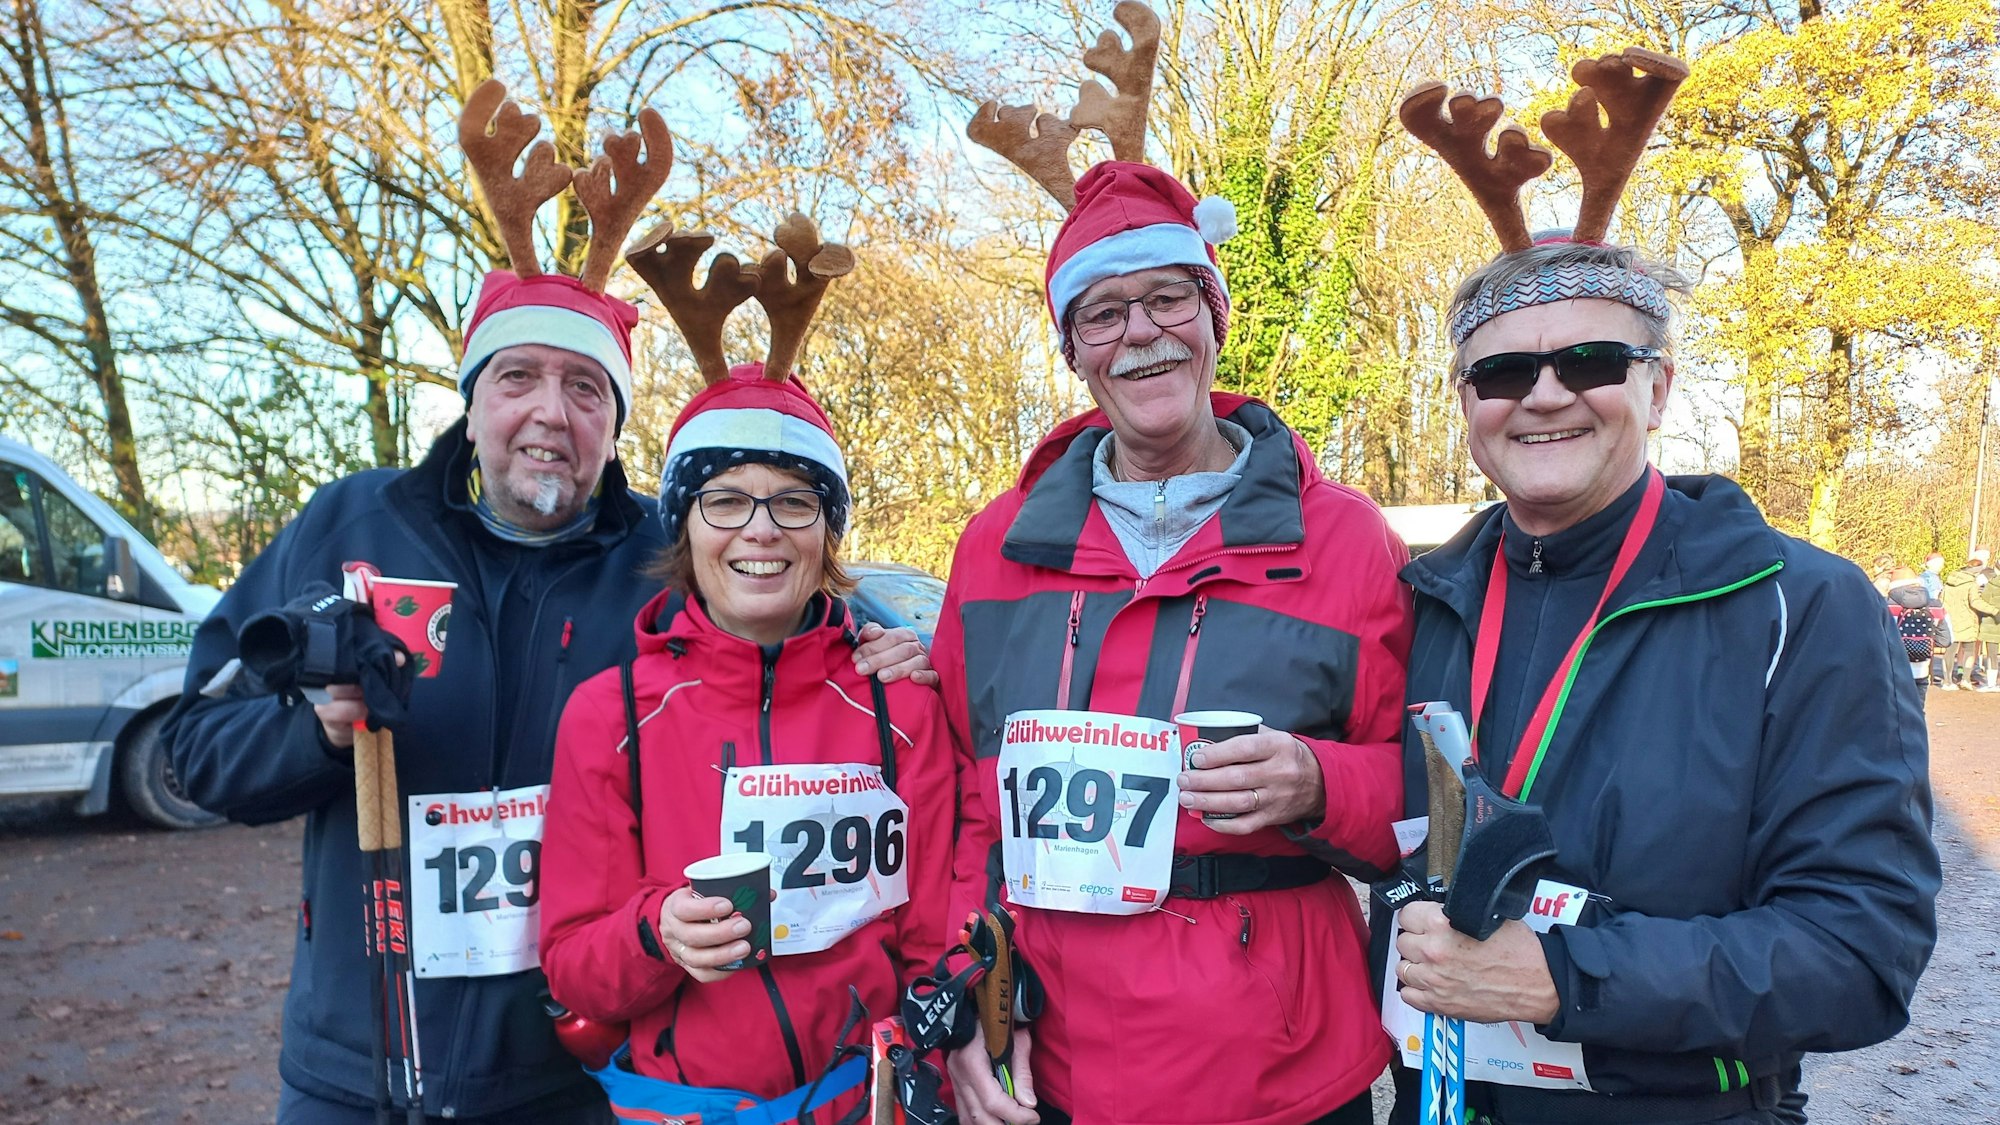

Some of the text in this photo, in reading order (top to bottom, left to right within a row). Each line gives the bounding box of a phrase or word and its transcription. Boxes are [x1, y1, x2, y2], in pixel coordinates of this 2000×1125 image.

[1006, 719, 1170, 752] Glühweinlauf
[1003, 766, 1171, 848] 1297
[1475, 795, 1485, 824] Comfort
[733, 809, 904, 890] 1296
[1053, 845, 1099, 855] Marienhagen
[1079, 883, 1115, 897] eepos
[389, 879, 407, 955] LEKI
[916, 990, 953, 1036] LEKI
[998, 979, 1008, 1025] LEKI
[1487, 1057, 1525, 1071] eepos
